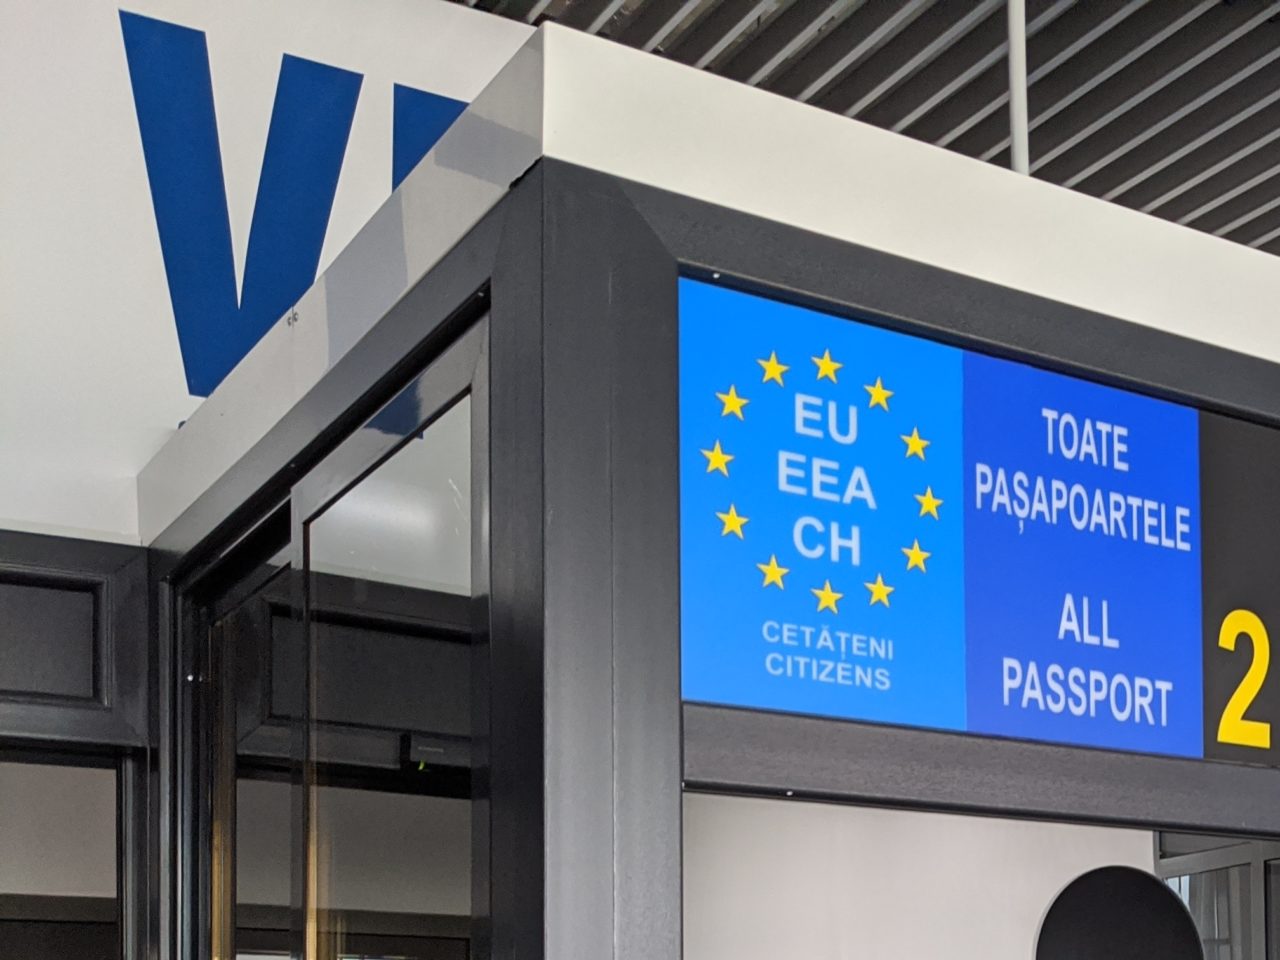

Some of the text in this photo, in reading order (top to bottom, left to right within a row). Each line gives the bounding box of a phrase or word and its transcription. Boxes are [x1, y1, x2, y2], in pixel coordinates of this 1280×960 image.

[794, 392, 858, 444] EU
[1041, 407, 1129, 472] TOATE
[777, 449, 877, 510] EEA
[975, 462, 1191, 551] PAȘAPOARTELE
[792, 515, 861, 566] CH
[762, 620, 893, 661] CETĂȚENI
[1058, 593, 1120, 649] ALL
[765, 652, 891, 691] CITIZENS
[1002, 657, 1173, 727] PASSPORT
[1217, 609, 1271, 750] 2
